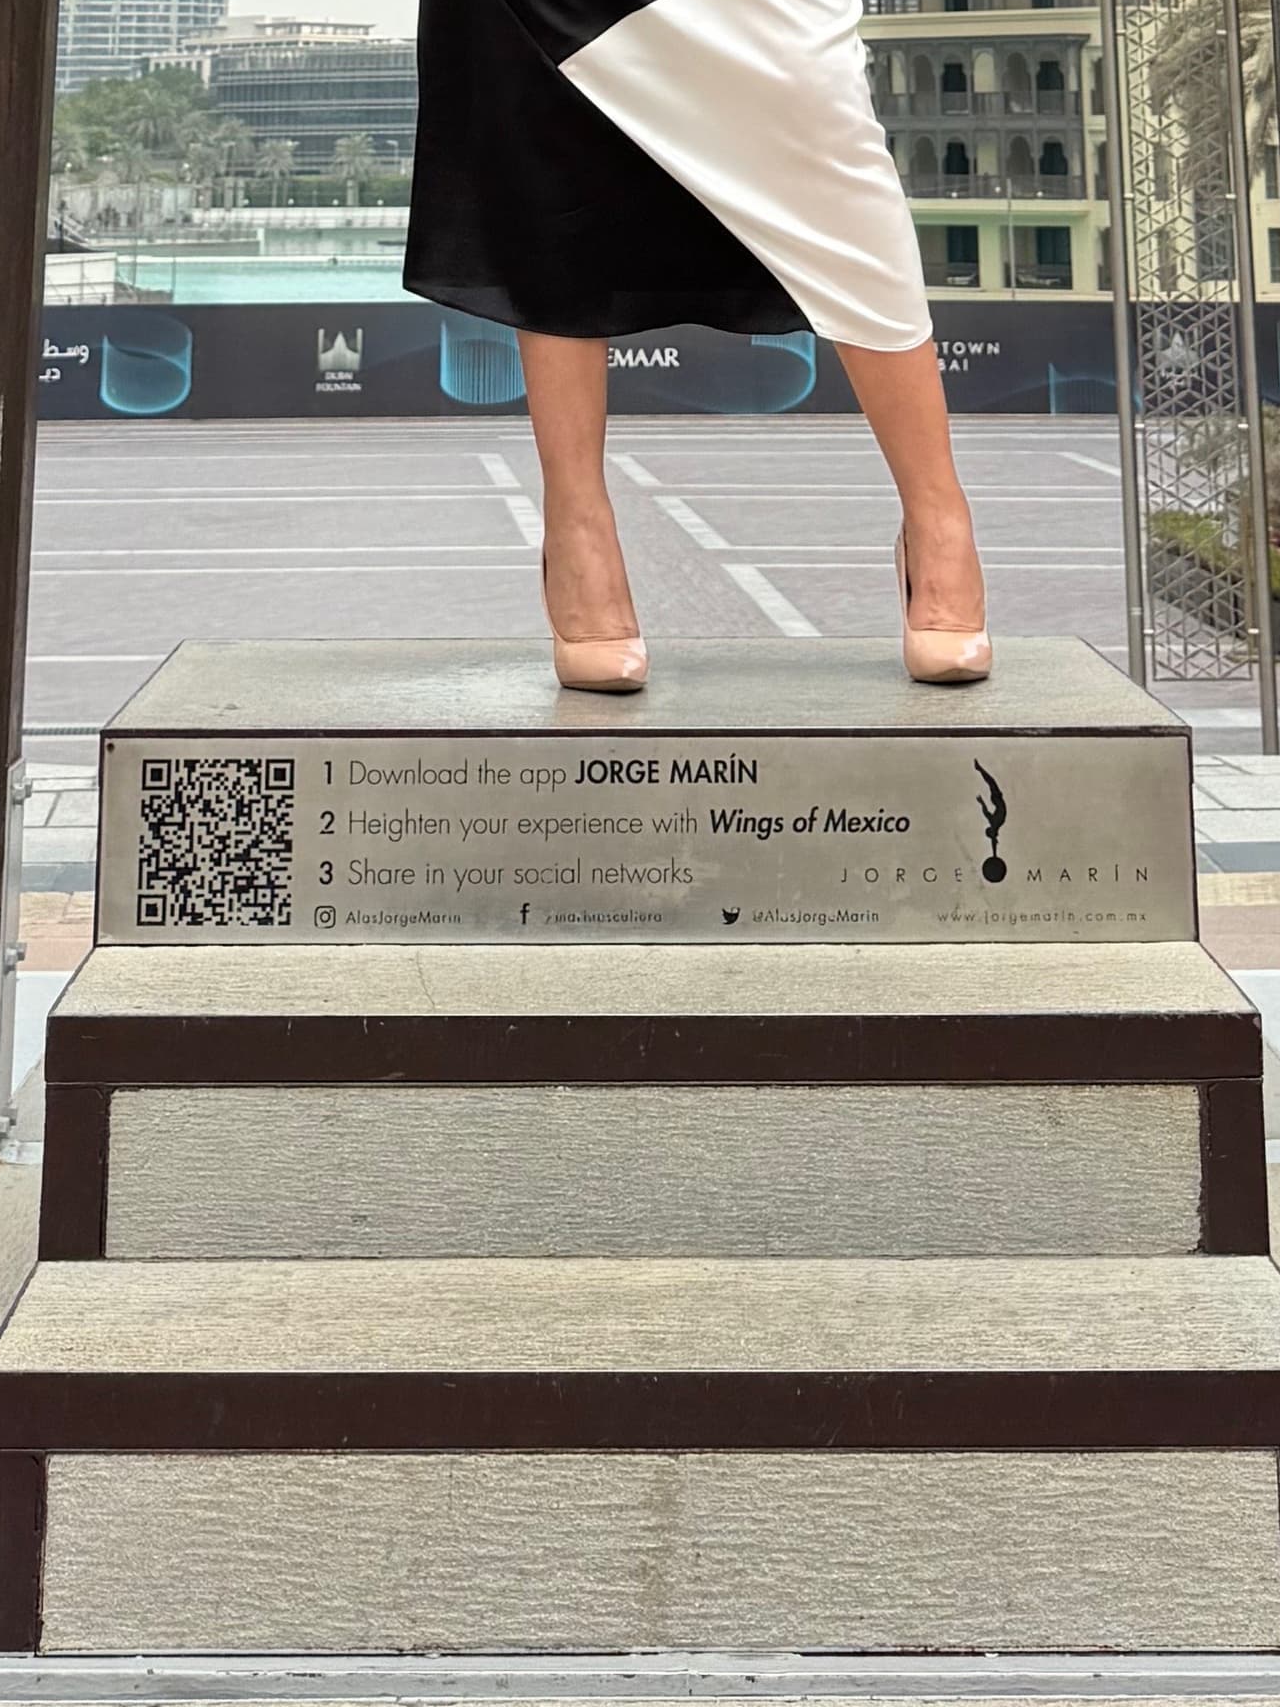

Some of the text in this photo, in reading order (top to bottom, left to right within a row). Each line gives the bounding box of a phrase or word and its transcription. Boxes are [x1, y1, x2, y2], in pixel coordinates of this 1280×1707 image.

[323, 753, 758, 792] 1 Download the app JORGE MARÍN
[319, 806, 911, 841] 2 Heighten your experience with Wings of Mexico
[318, 857, 694, 892] 3 Share in your social networks
[840, 863, 1150, 884] JORGE MARÍN
